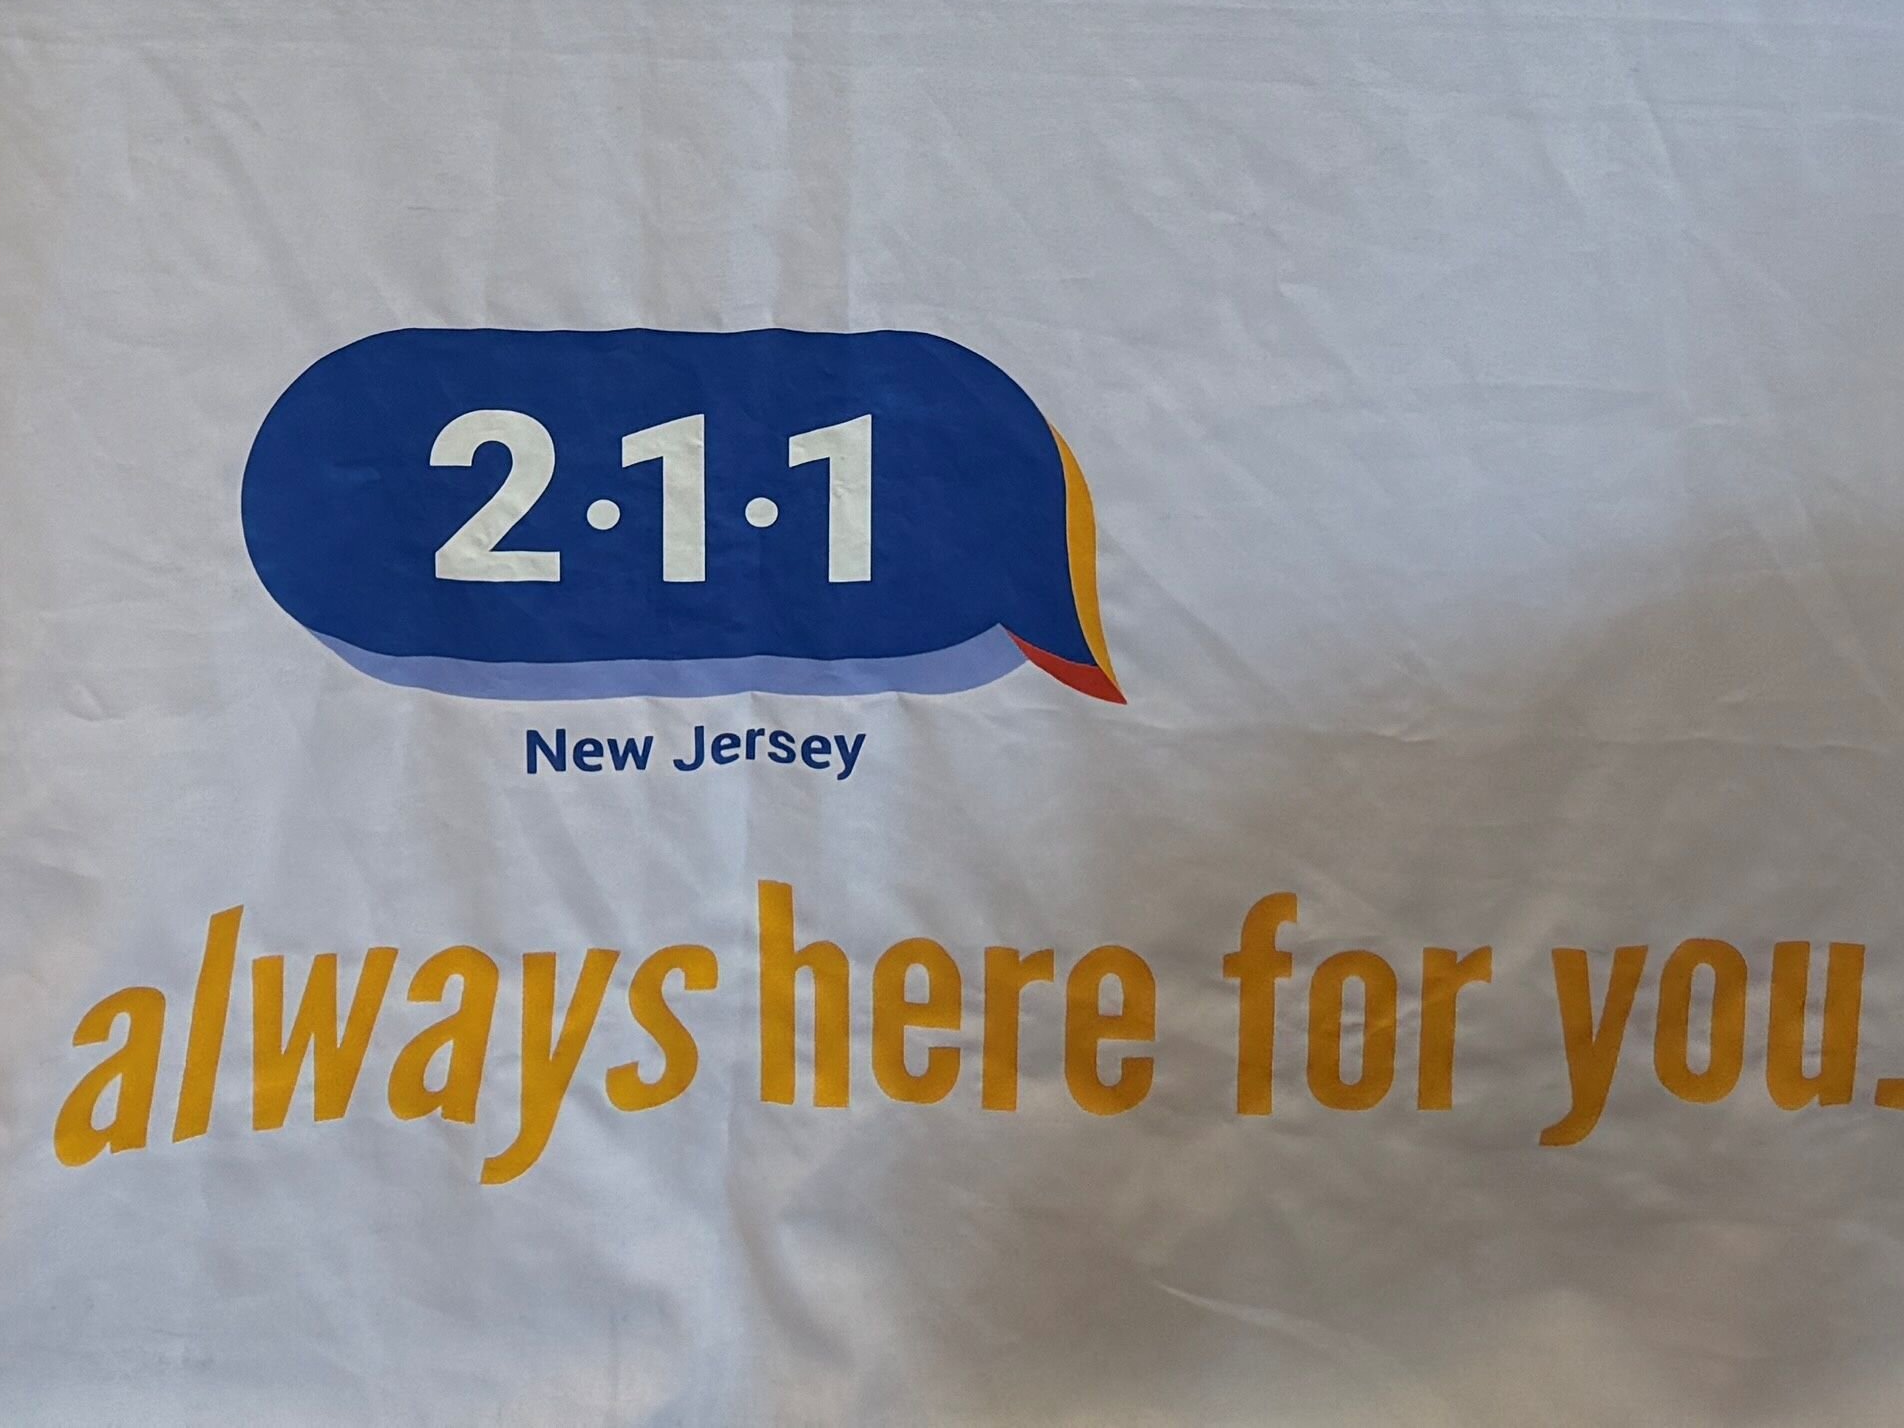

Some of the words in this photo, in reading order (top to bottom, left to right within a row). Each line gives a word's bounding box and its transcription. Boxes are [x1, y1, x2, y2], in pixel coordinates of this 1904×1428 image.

[527, 728, 652, 774] New
[674, 725, 865, 780] Jersey
[54, 908, 717, 1184] always
[759, 882, 1155, 1116] here
[1224, 892, 1492, 1116] for
